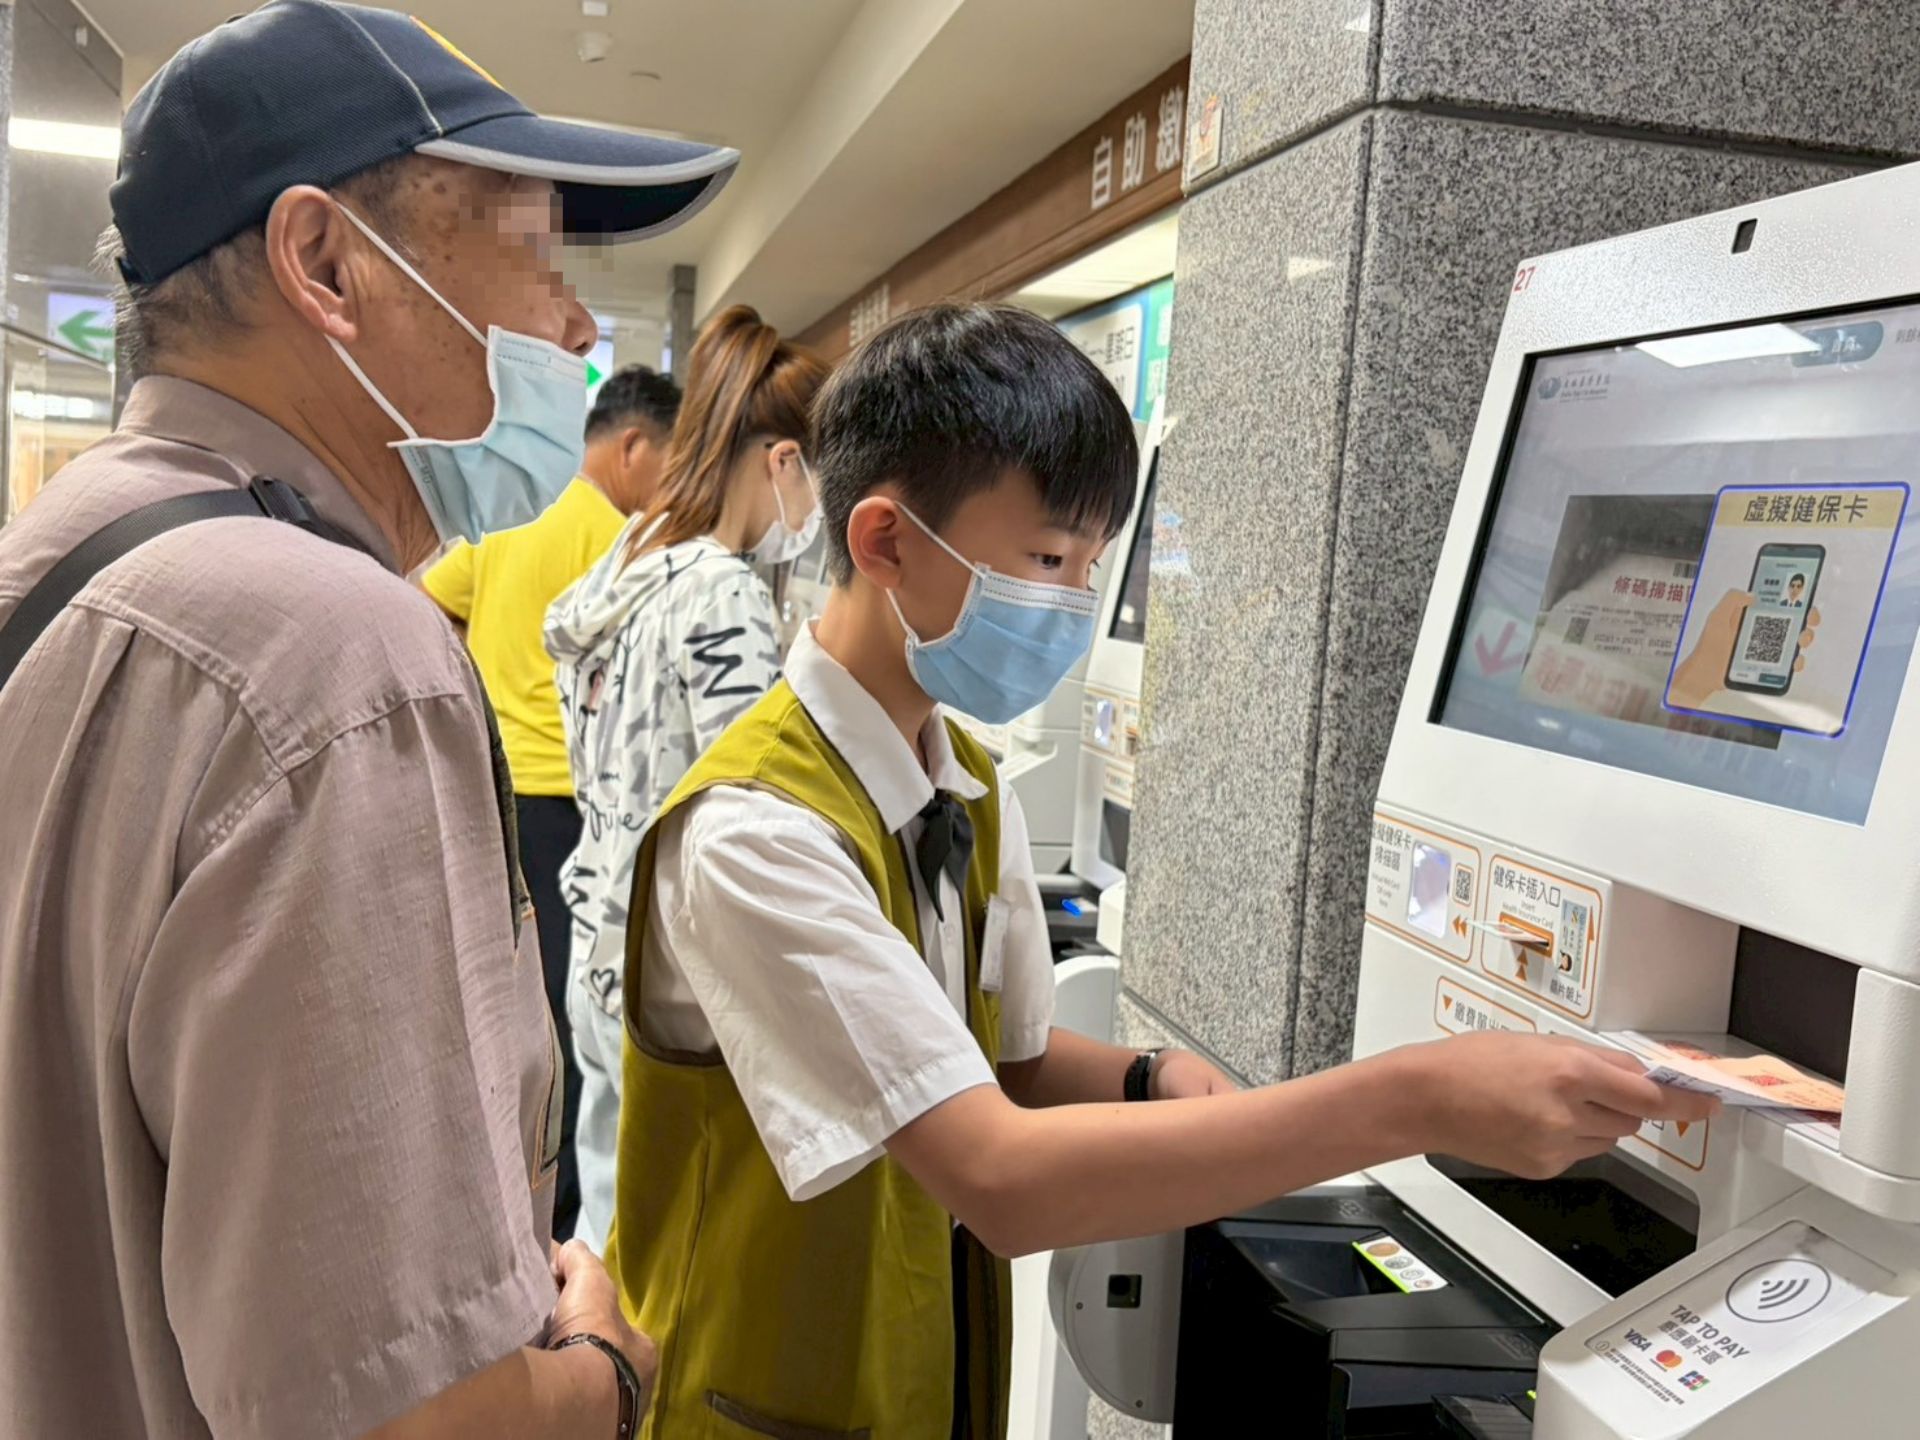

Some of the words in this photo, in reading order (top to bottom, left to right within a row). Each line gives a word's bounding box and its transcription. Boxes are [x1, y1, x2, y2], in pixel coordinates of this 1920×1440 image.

[1514, 266, 1536, 291] 27
[1743, 494, 1868, 523] 虛擬健保卡
[1612, 575, 1693, 603] 條碼掃描
[1493, 864, 1561, 908] 健保卡插入口
[1624, 1328, 1653, 1352] VISA
[1670, 1304, 1702, 1325] TAP
[1696, 1321, 1720, 1340] TO
[1713, 1335, 1751, 1359] PAY
